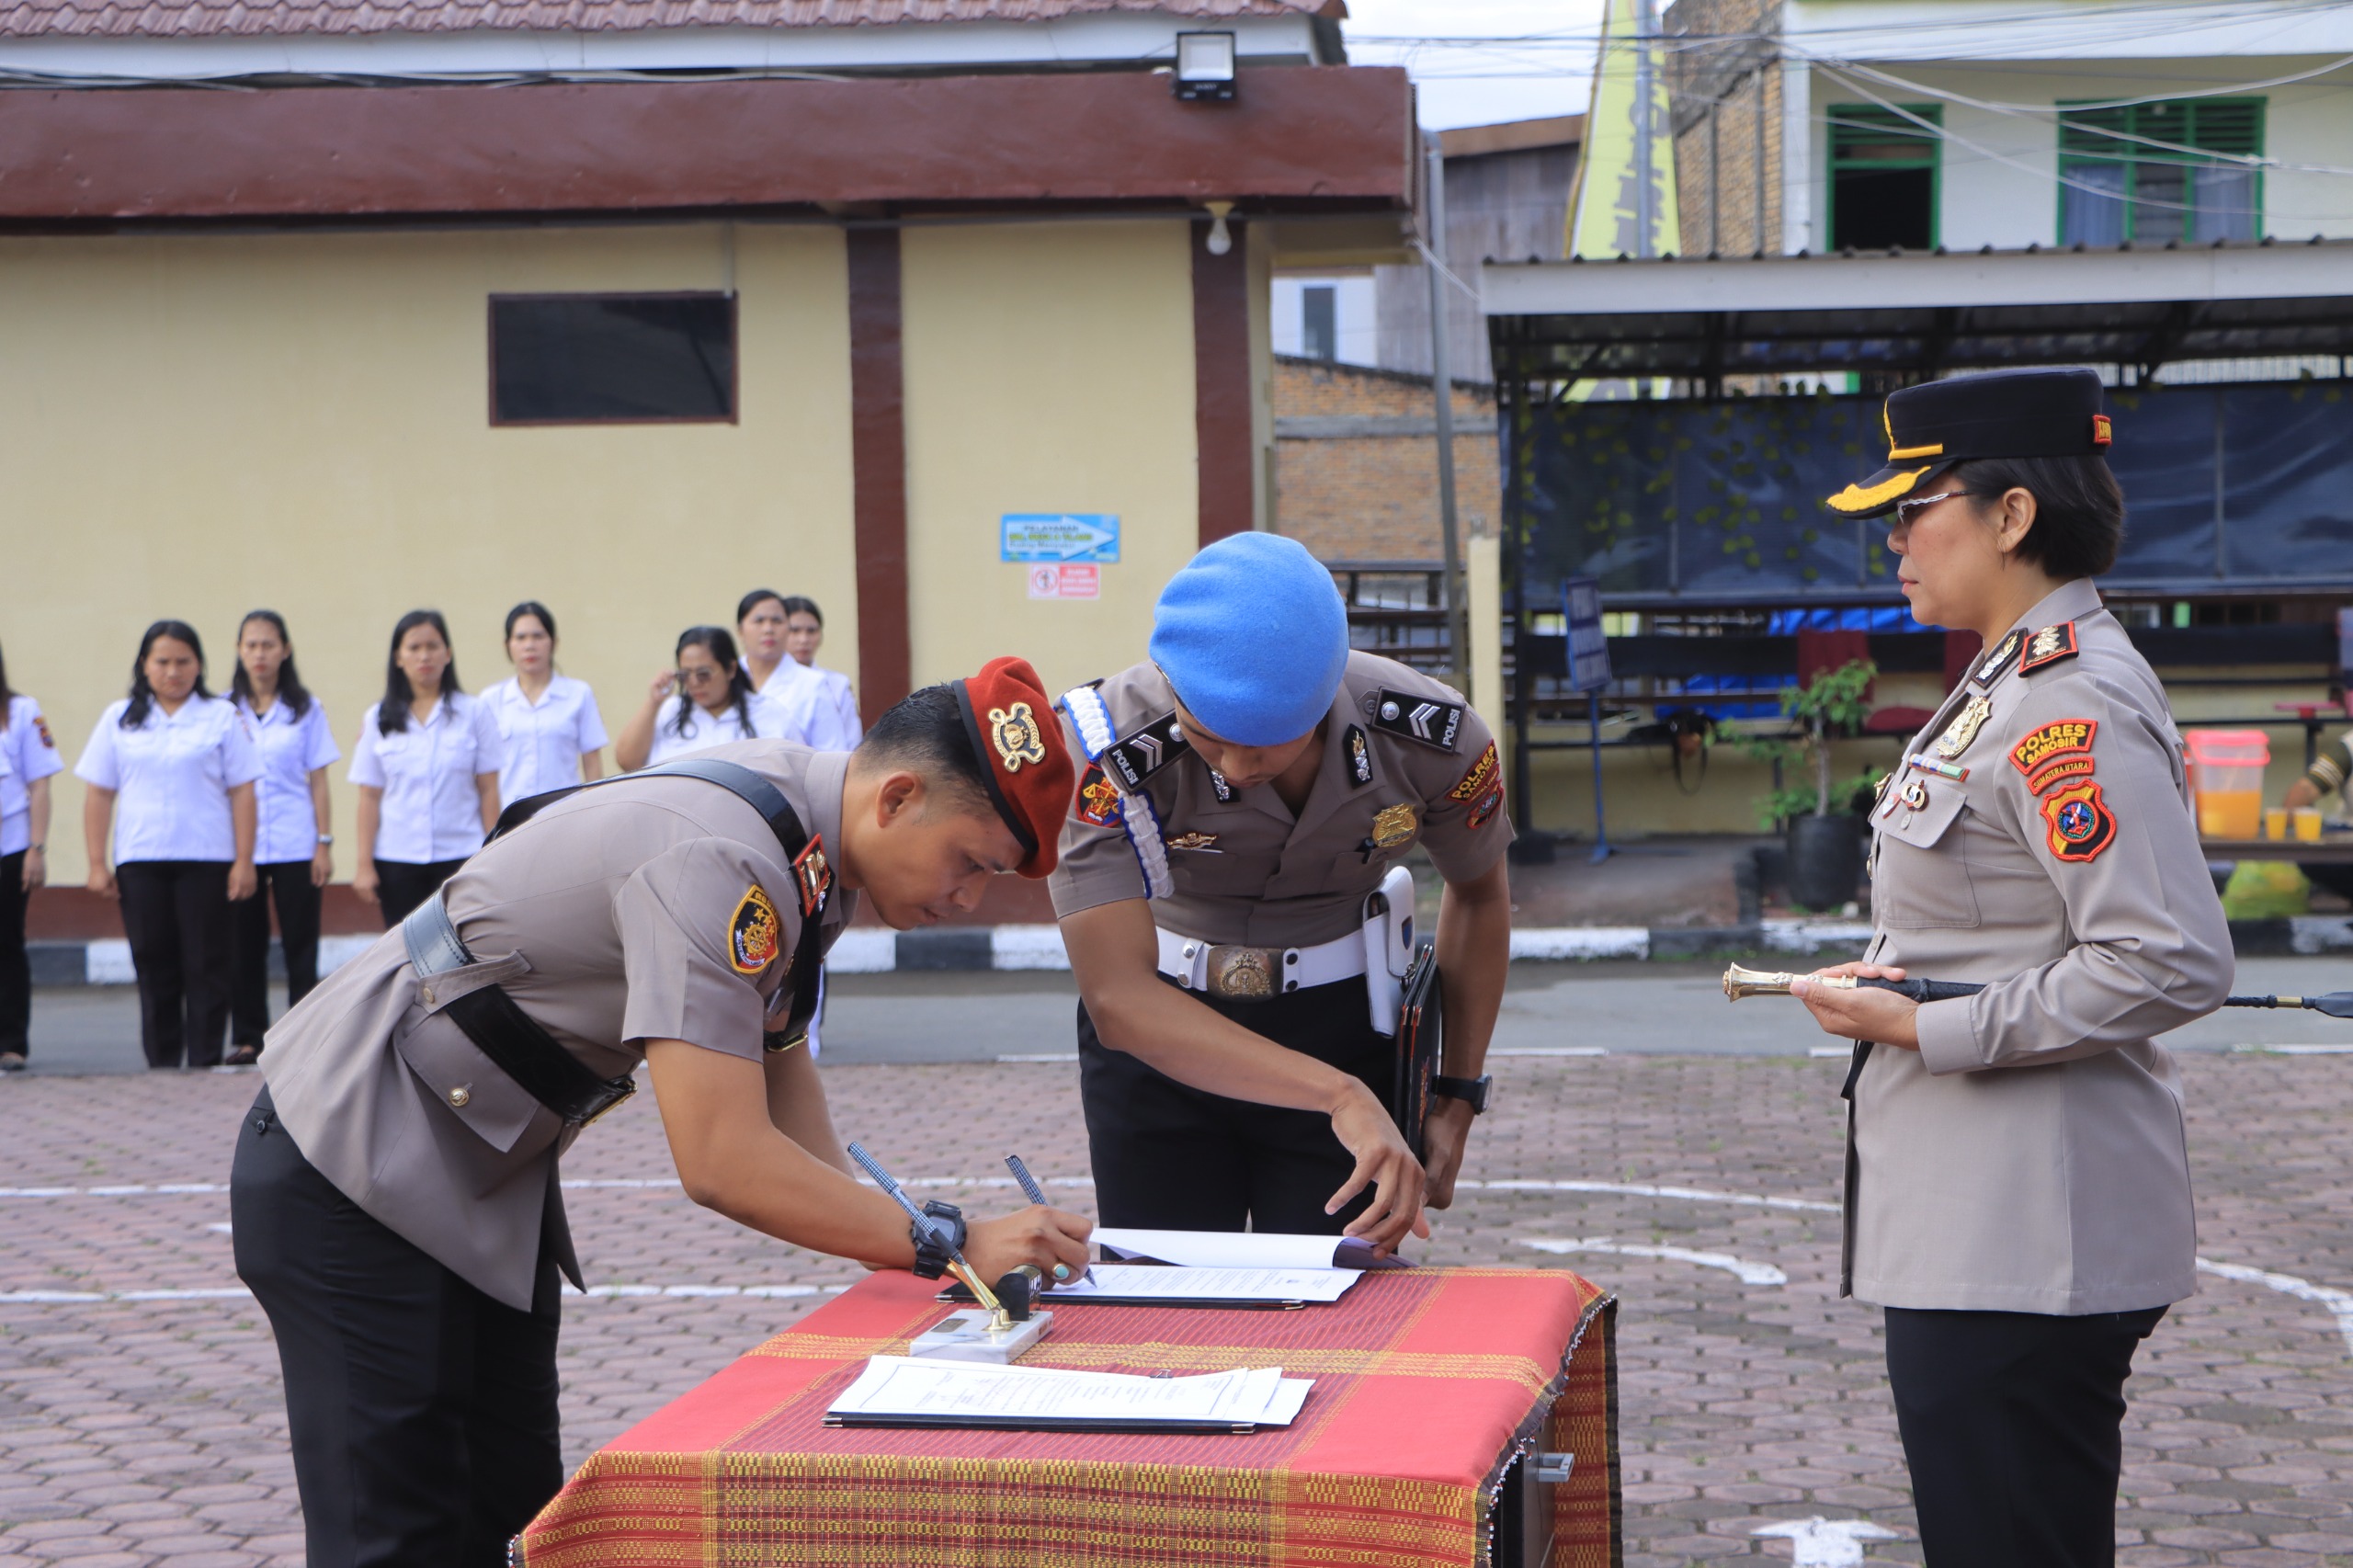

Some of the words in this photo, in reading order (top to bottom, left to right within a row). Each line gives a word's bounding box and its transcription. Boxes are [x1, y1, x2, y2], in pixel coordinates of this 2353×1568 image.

[1442, 709, 1461, 746] POLISI
[2016, 724, 2087, 762] POLRES
[1112, 748, 1140, 785] POLISI
[2027, 736, 2079, 764] SAMOSIR
[1451, 745, 1495, 799] POLRES
[1463, 756, 1495, 799] SAMOSIR
[2033, 766, 2064, 788] SUMATERA
[2065, 762, 2089, 771] UTARA
